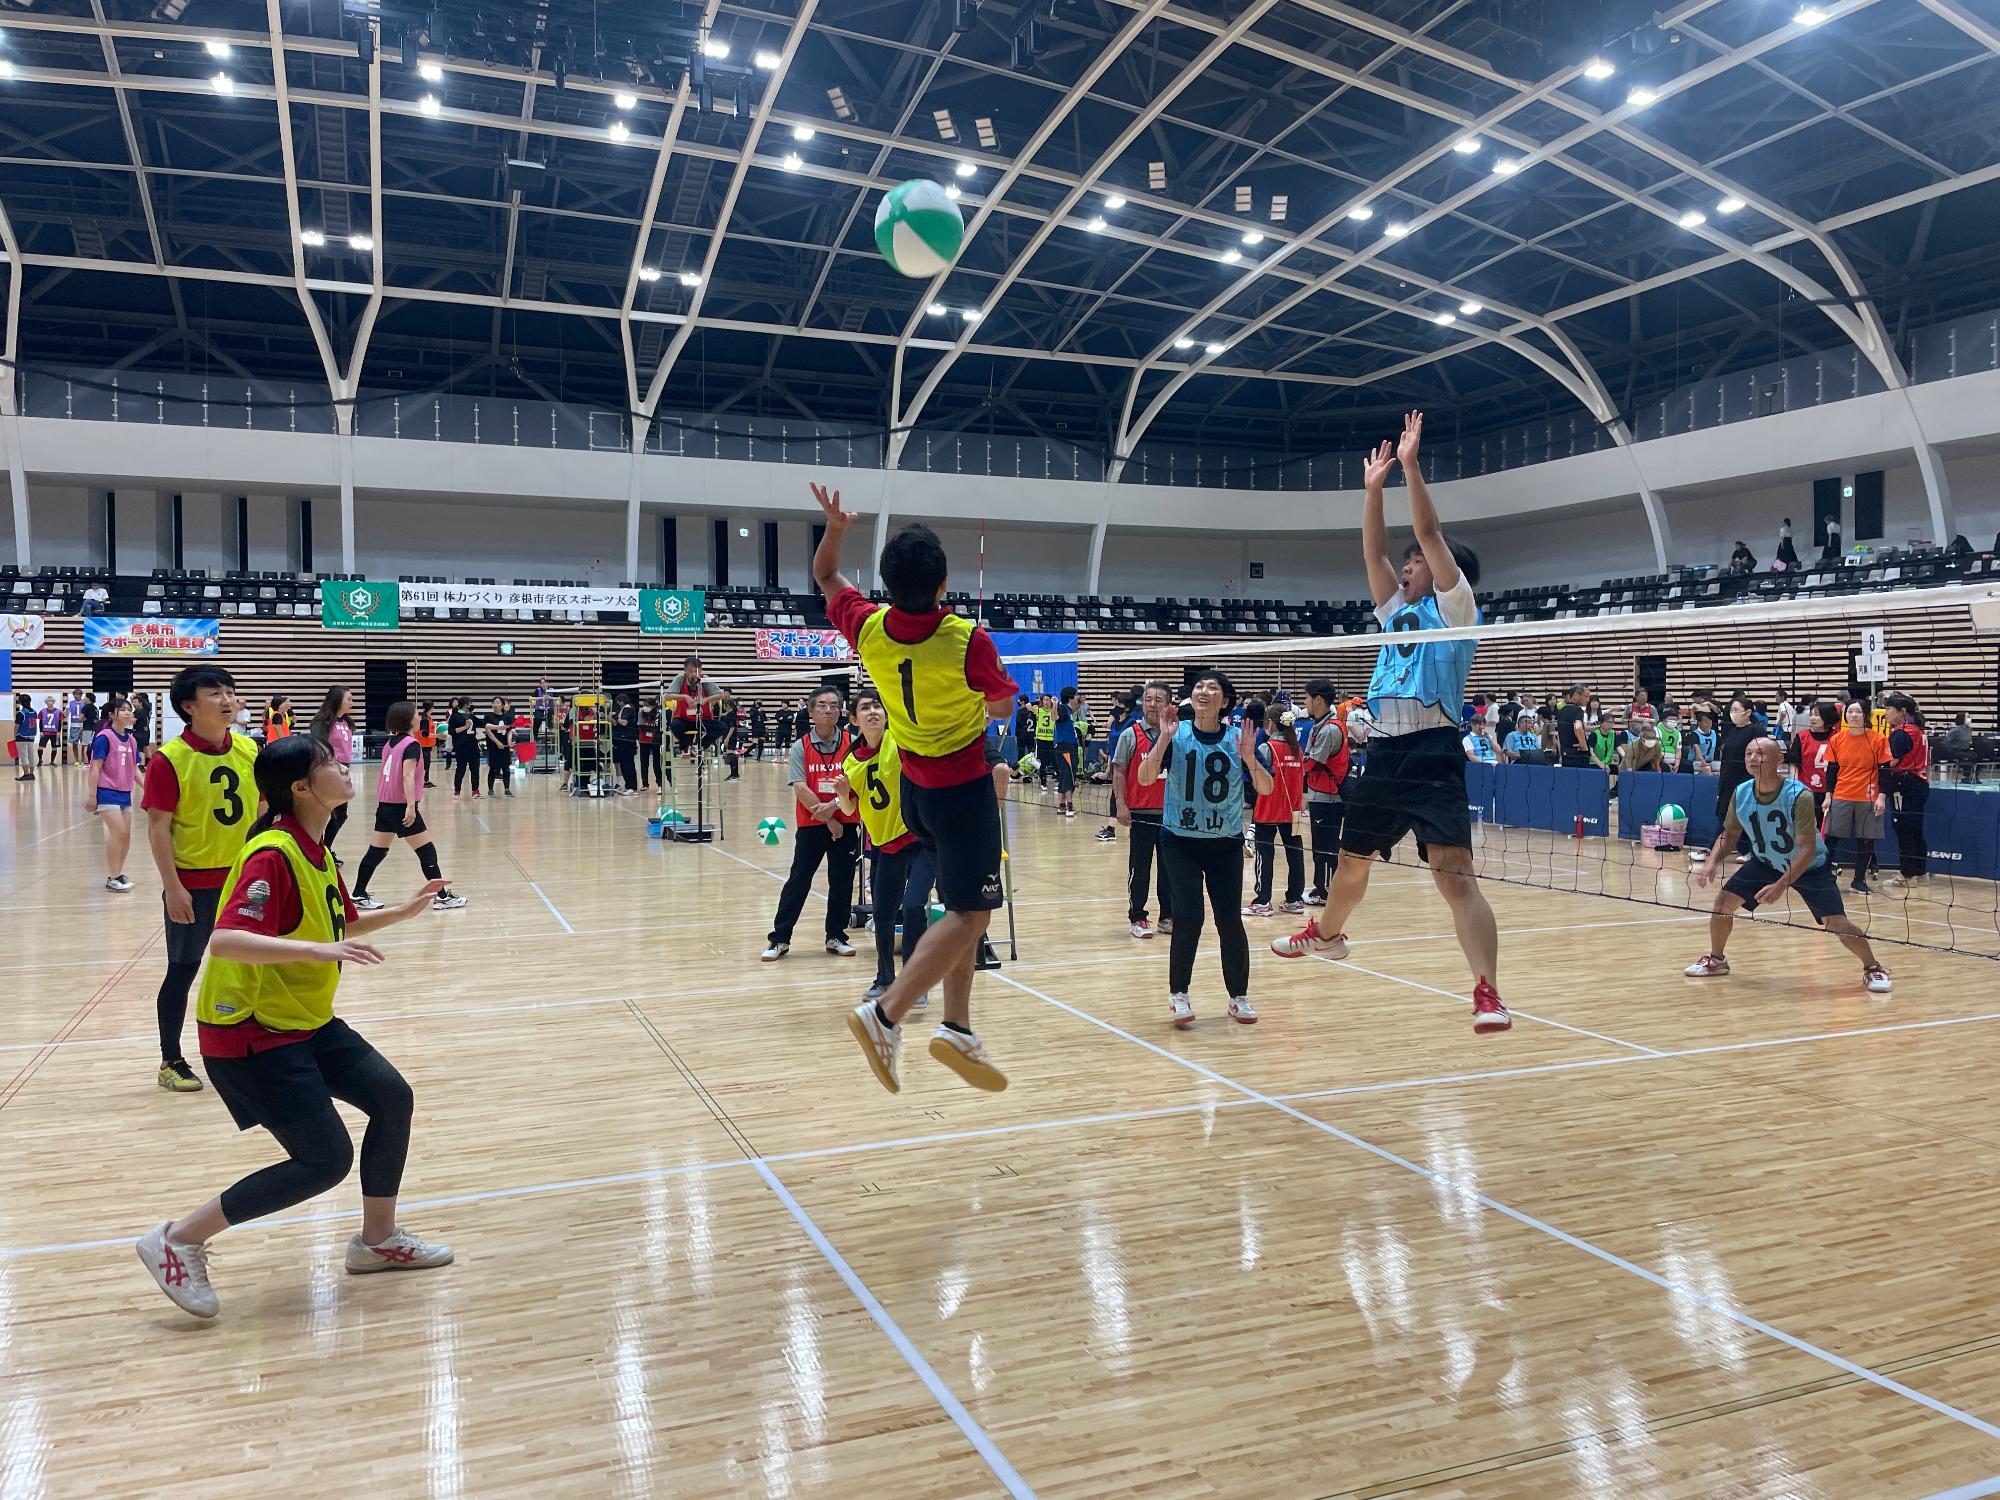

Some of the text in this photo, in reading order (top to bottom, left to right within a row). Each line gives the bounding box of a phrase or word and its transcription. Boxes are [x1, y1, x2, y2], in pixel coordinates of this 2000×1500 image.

[400, 589, 637, 607] 第61回 体力づくり 彦根市学区スポーツ大会
[130, 623, 176, 636] 彦根市
[769, 631, 822, 645] スポーツ
[100, 636, 205, 649] スポーツ推進委員
[779, 644, 835, 658] 推進委員
[1869, 633, 1876, 652] 8
[897, 657, 919, 727] 1
[1026, 719, 1035, 732] 2
[1042, 715, 1051, 727] 3
[1814, 743, 1829, 773] 4
[382, 754, 393, 782] 4
[1184, 750, 1231, 804] 18
[209, 765, 244, 826] 3
[867, 763, 891, 811] 5
[1749, 809, 1795, 855] 13
